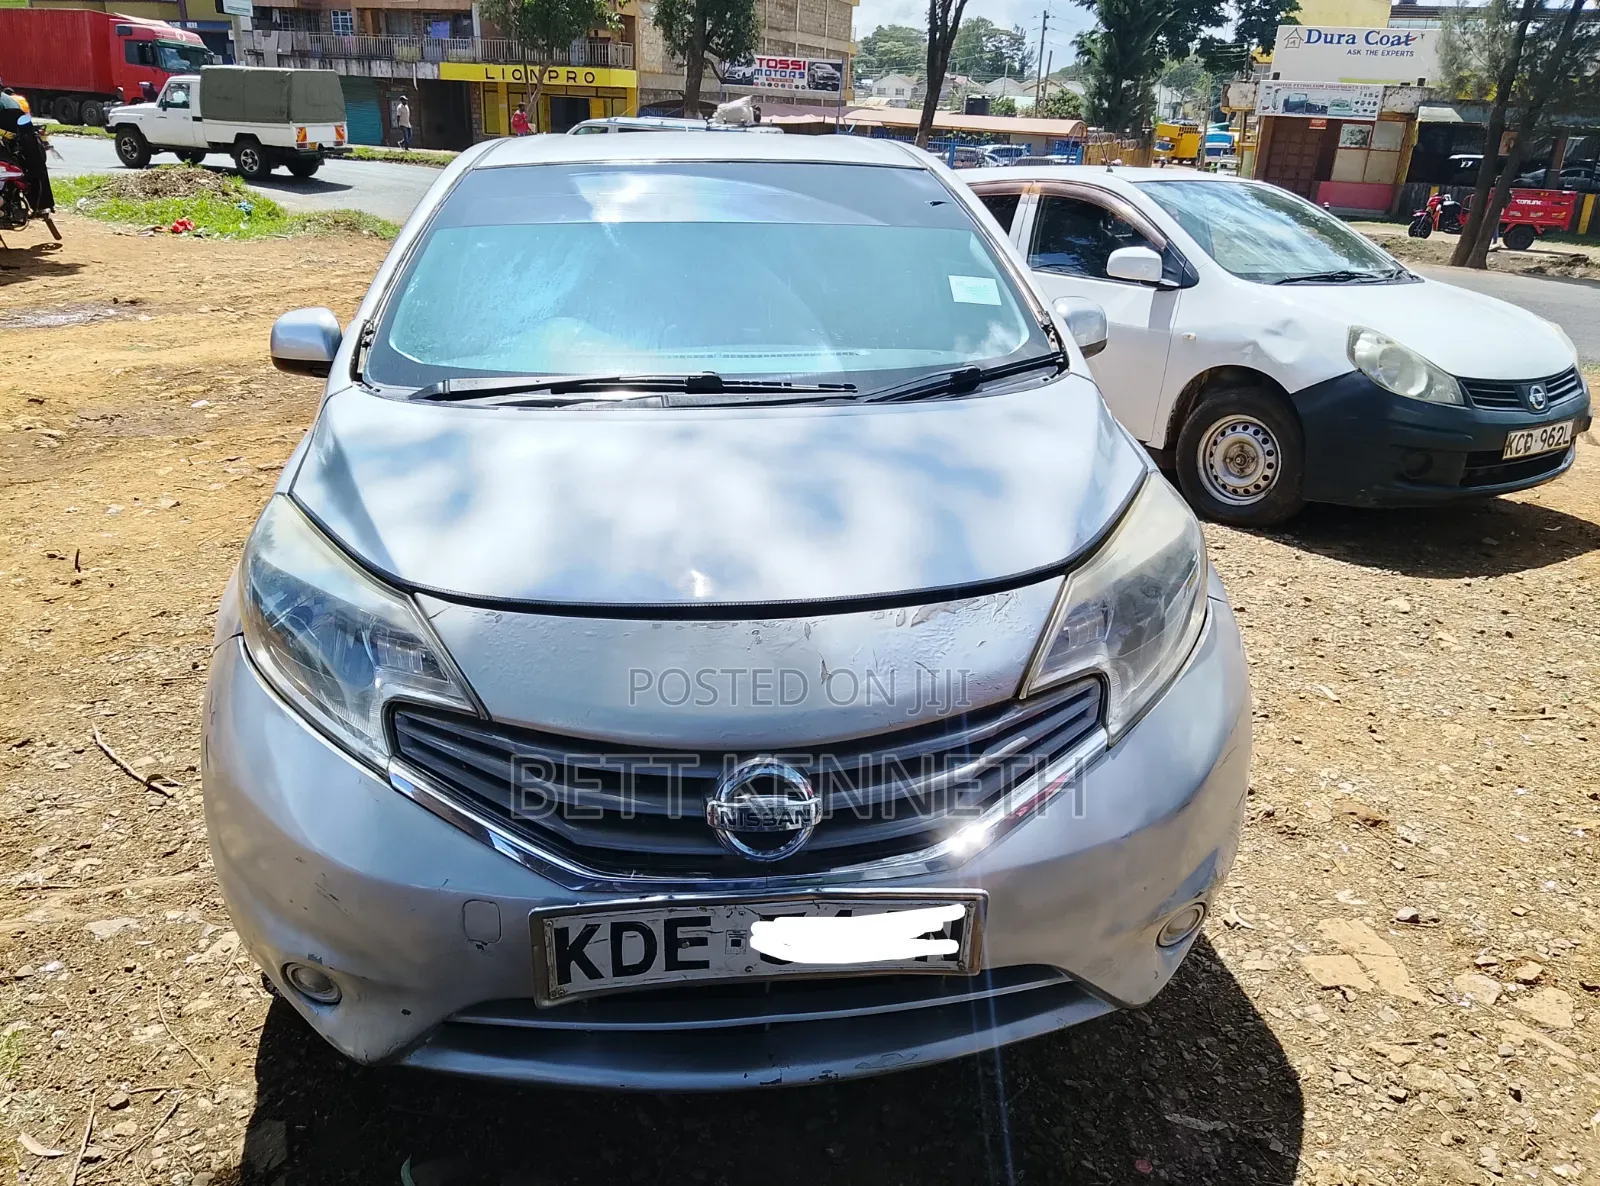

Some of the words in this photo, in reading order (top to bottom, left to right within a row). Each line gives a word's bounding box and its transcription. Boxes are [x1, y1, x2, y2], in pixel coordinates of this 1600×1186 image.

[1305, 28, 1357, 45] Dura
[1364, 30, 1415, 47] Coat
[754, 69, 805, 79] MOTORS
[756, 58, 806, 71] TOSSI
[1540, 424, 1570, 450] 962L
[720, 808, 811, 827] NISSAN
[555, 916, 711, 985] KDE
